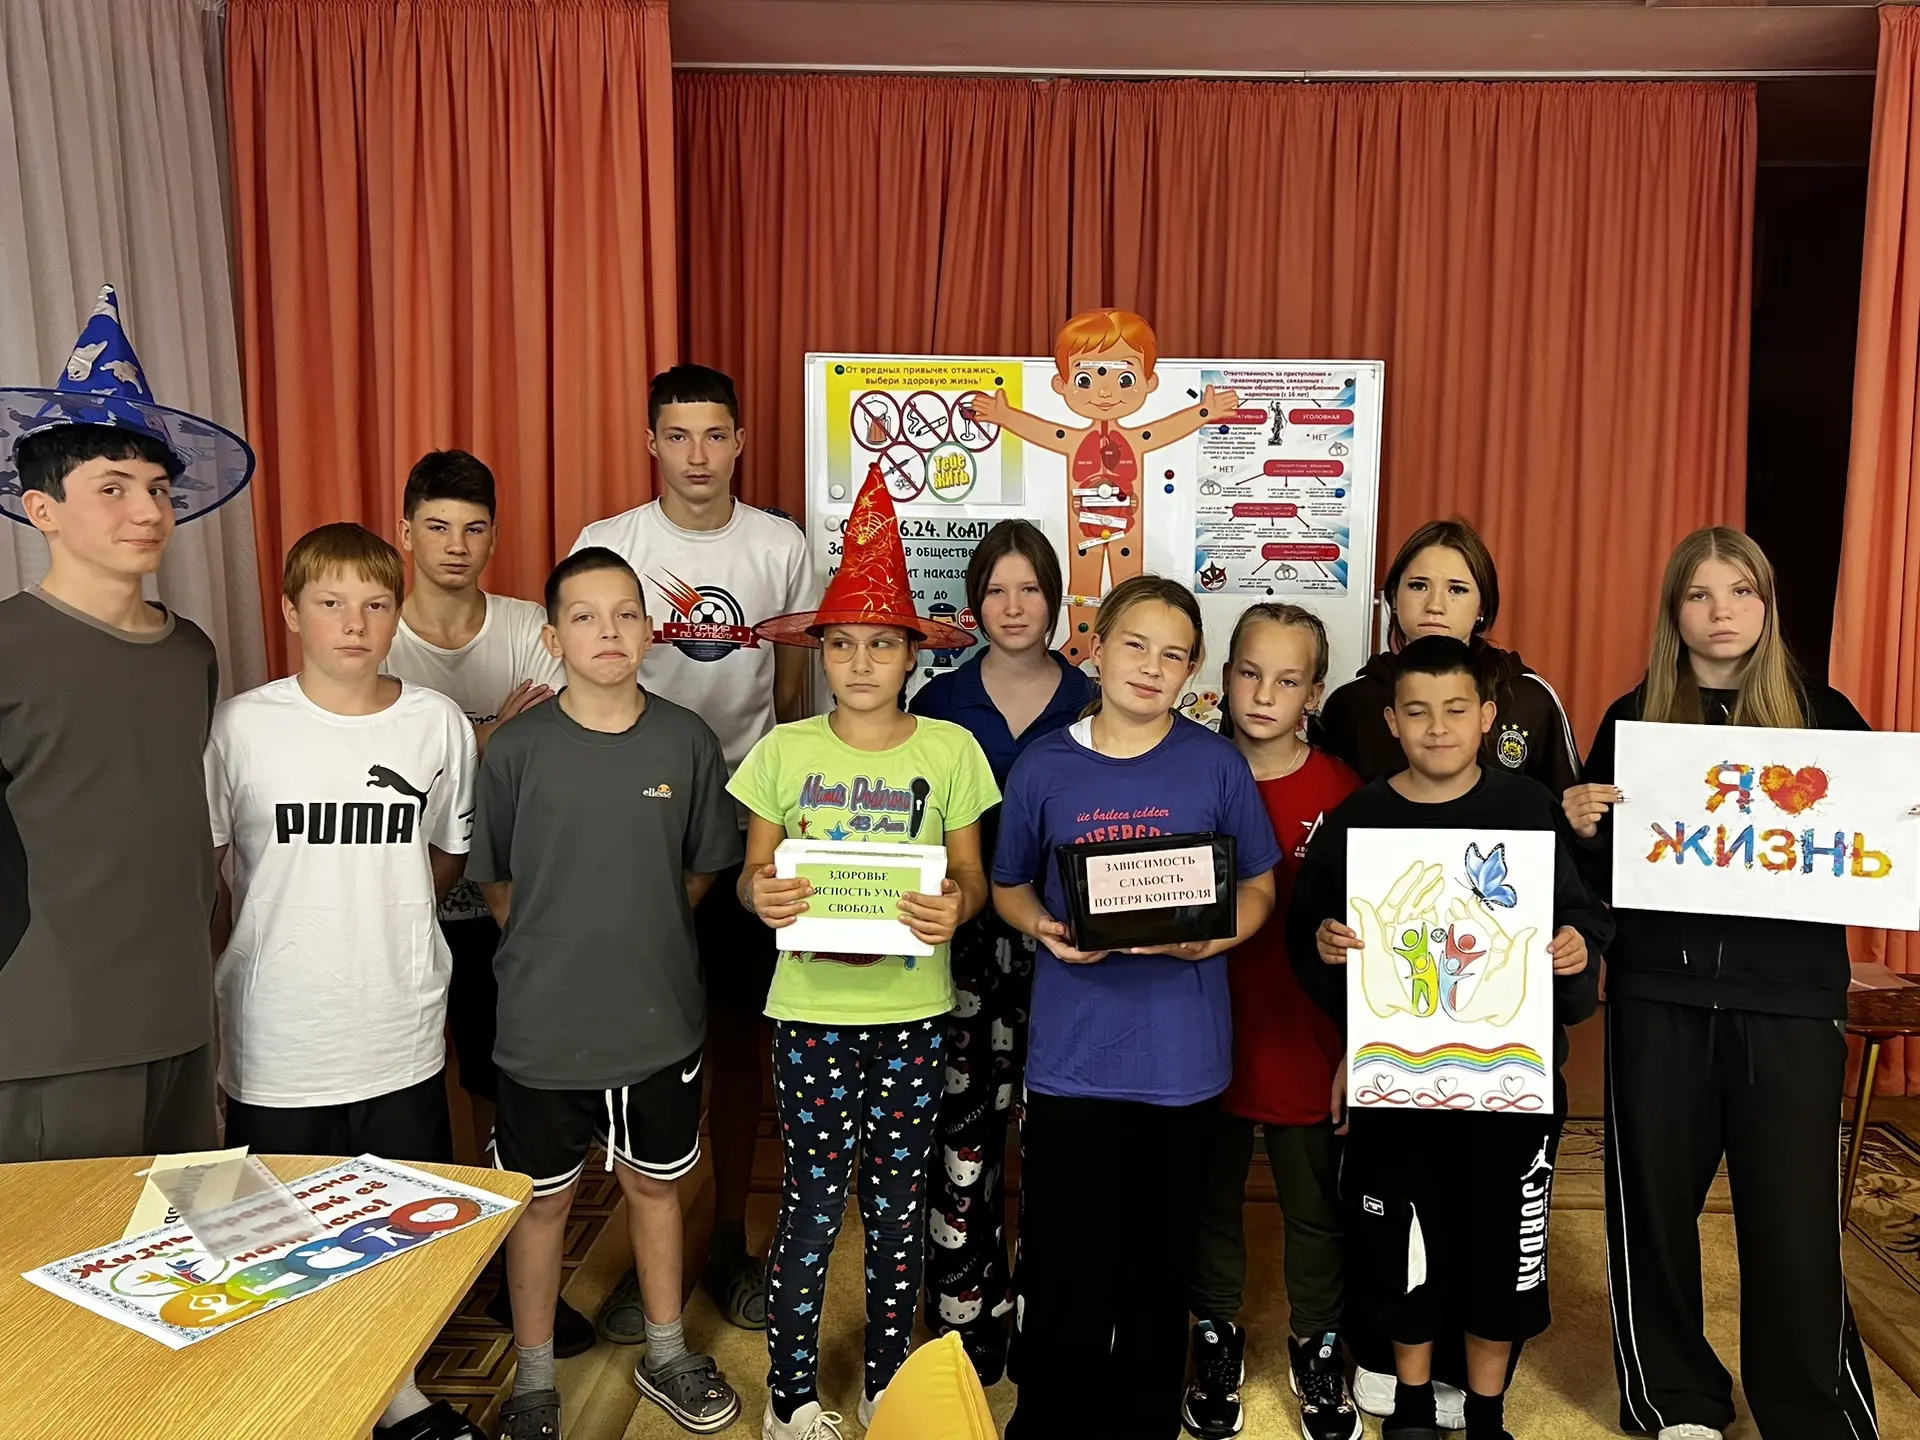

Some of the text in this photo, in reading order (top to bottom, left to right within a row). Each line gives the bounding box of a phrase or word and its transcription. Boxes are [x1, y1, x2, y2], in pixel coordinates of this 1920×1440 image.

[846, 366, 857, 374] От
[861, 367, 900, 376] вредных
[903, 367, 948, 376] привычек
[865, 376, 982, 387] выбери здоровую жизнь!
[1302, 413, 1341, 421] УГОЛОВНАЯ
[1312, 433, 1328, 442] НЕТ
[1219, 465, 1235, 473] НЕТ
[916, 547, 974, 558] обществе
[923, 569, 967, 579] наказа
[933, 592, 948, 600] до
[685, 623, 731, 632] ТУРНИР
[695, 631, 733, 640] ФУТБОЛУ
[1704, 760, 1754, 815] Я
[275, 803, 415, 844] PUMA
[1645, 820, 1893, 878] ЖИЗНЬ
[1105, 856, 1196, 873] ЗАВИСИМОСТЬ
[828, 870, 889, 881] ЗДОРОВЬЕ
[1119, 873, 1184, 888] СЛАБОСТЬ
[814, 886, 901, 898] ЯСНОСТЬ УМА
[1094, 888, 1211, 908] ПОТЕРЯ КОНТРОЛЯ
[828, 903, 885, 914] СВОБОДА
[1516, 1182, 1545, 1291] JORDAN
